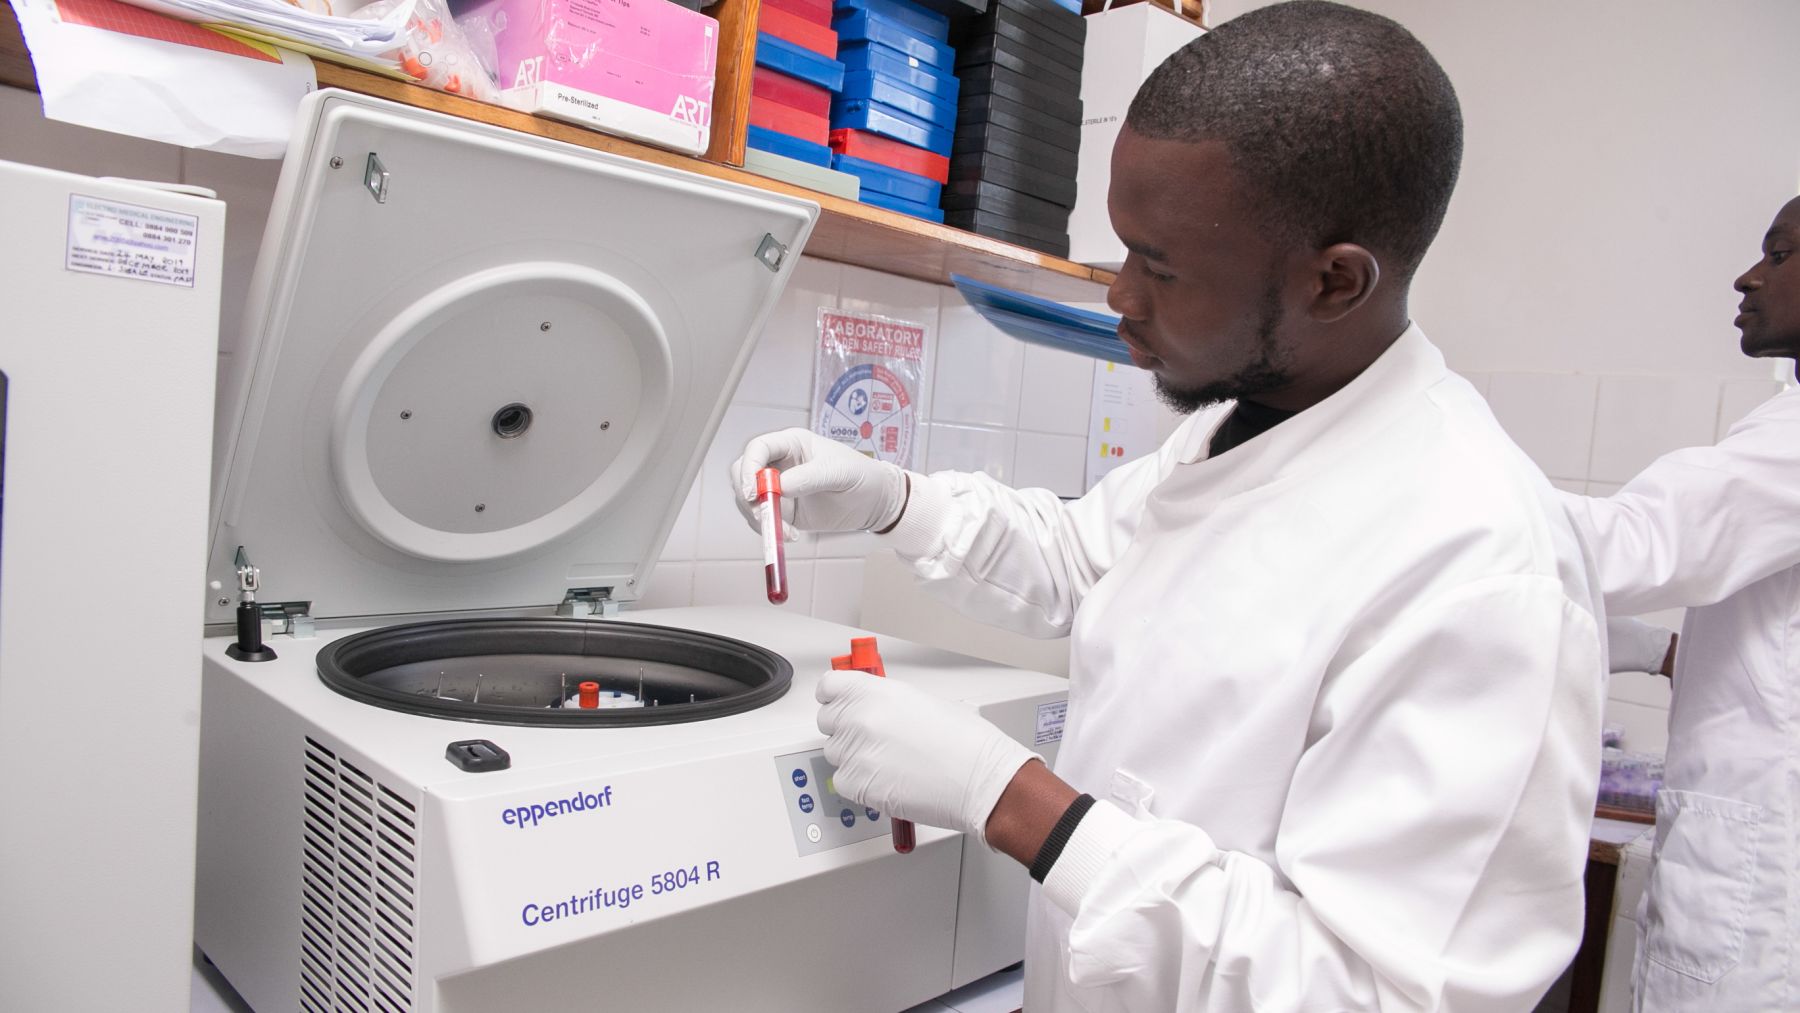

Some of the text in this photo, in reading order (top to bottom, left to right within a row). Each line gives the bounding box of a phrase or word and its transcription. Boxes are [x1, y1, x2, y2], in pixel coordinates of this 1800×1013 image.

[514, 56, 543, 88] ART
[558, 93, 599, 110] Pre-Sterilized
[670, 94, 708, 128] ART
[824, 334, 859, 351] GDEN
[862, 339, 893, 355] SAFETY
[825, 318, 920, 346] LABORATORY
[502, 785, 612, 829] eppendorf
[522, 861, 720, 926] Centrifuge 5804 R
